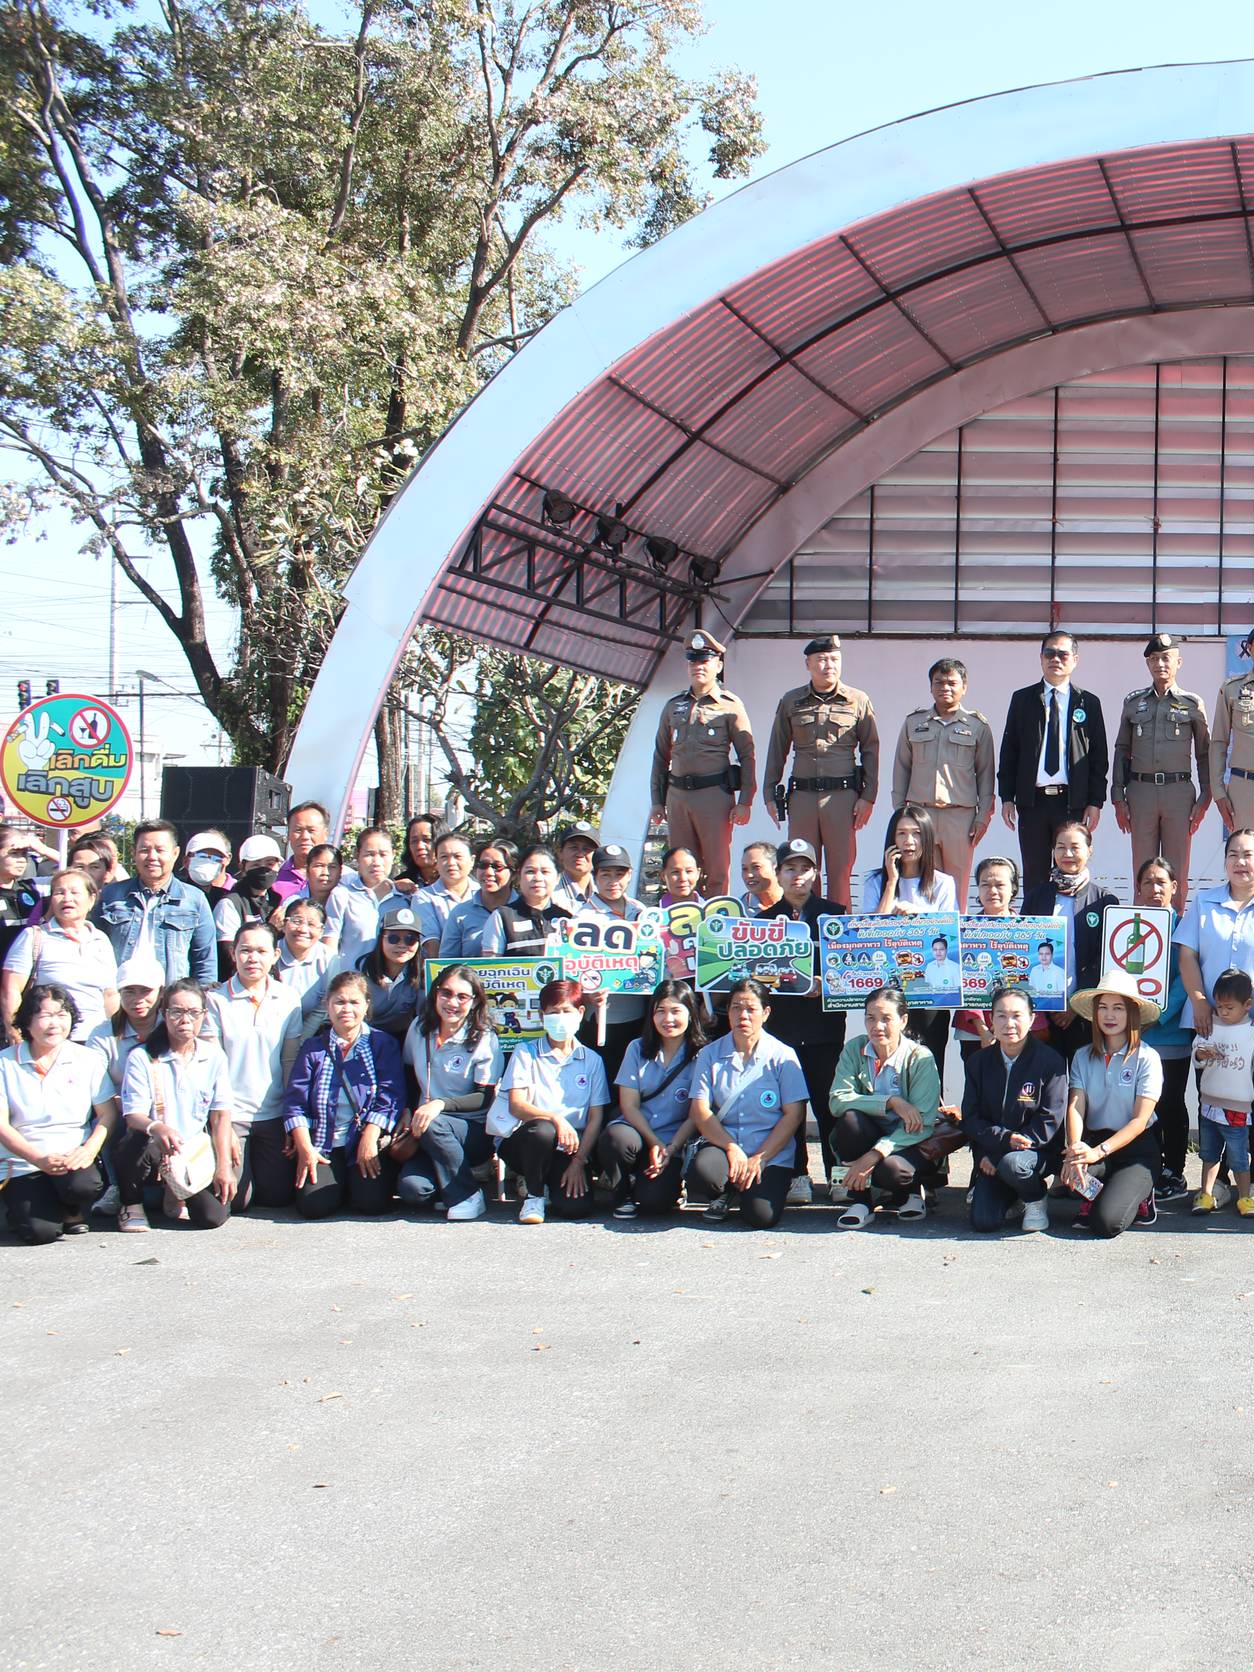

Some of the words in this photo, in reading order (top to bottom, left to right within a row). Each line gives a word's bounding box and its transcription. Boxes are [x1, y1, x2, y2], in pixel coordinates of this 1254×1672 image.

[50, 743, 128, 770] เลิกดื่ม
[17, 770, 114, 809] เลิกสูบ
[572, 921, 634, 950] ลด
[732, 917, 785, 942] ขับขี่
[718, 938, 812, 959] ปลอดภัย
[564, 955, 640, 976] อุบัติเหตุ
[848, 977, 883, 989] 1669
[962, 978, 987, 989] 669
[1136, 977, 1163, 996] O
